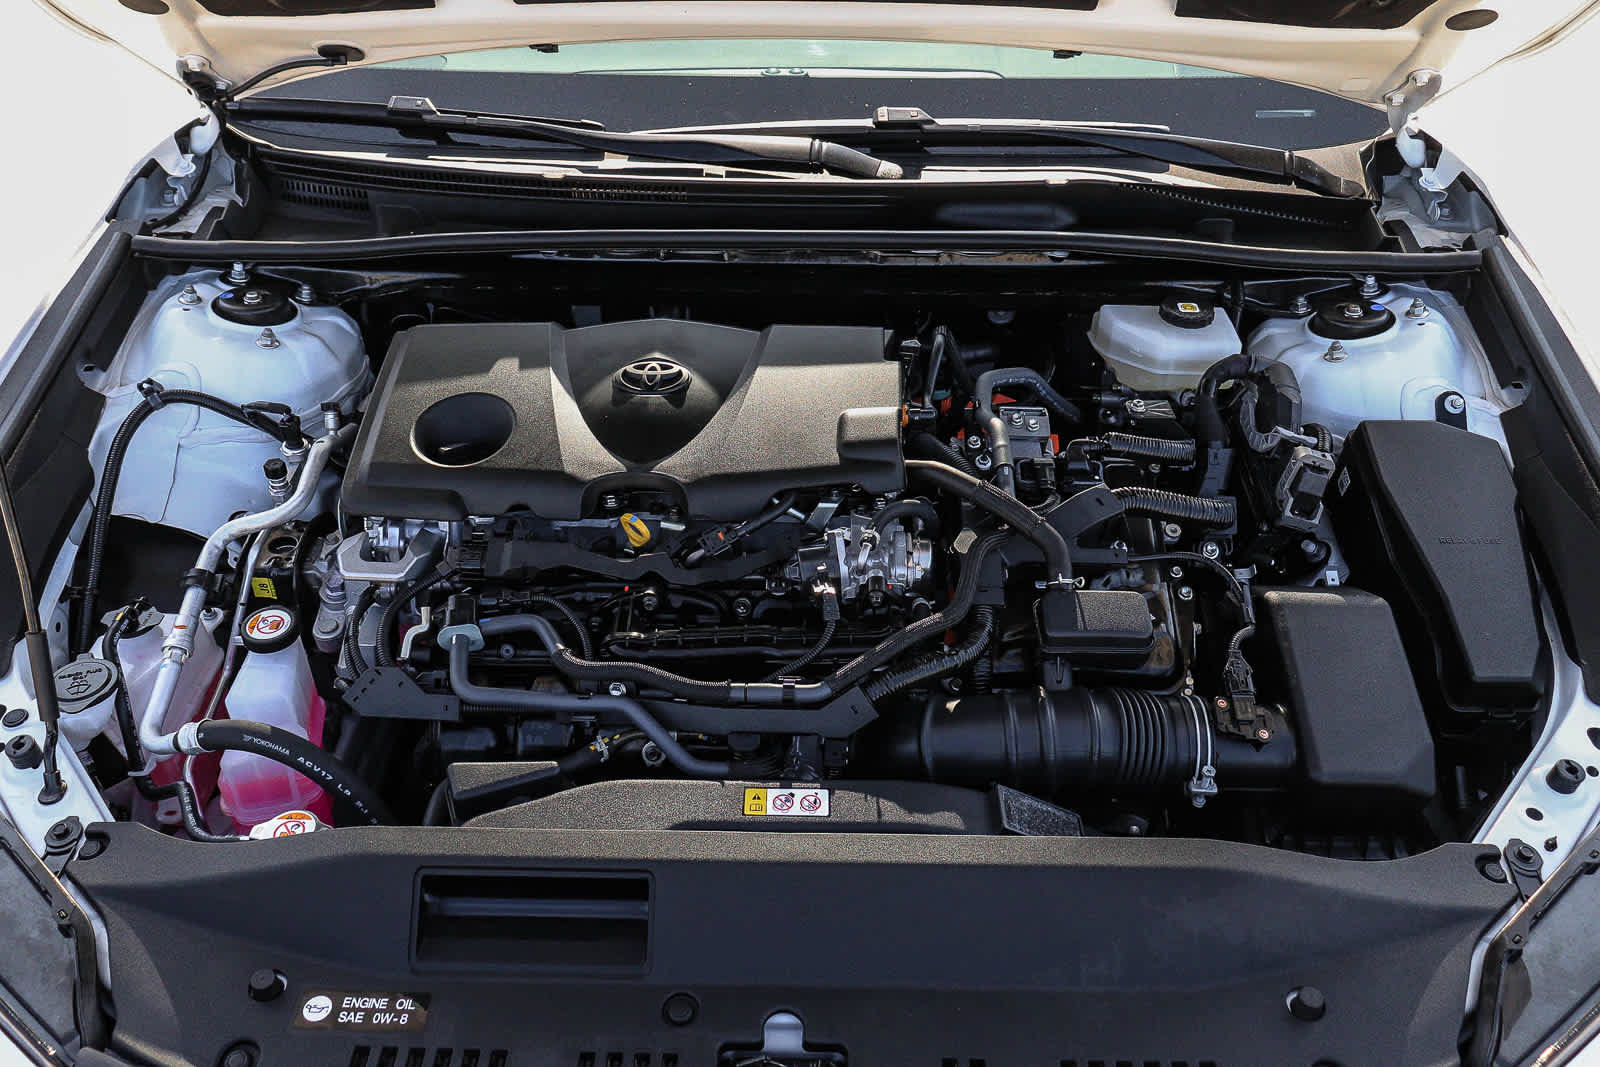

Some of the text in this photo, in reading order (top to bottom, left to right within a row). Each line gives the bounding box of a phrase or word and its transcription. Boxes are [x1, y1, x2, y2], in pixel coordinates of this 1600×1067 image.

[251, 736, 290, 755] YOKOHAMA
[297, 756, 334, 781] ACV17
[342, 996, 416, 1010] ENGINE OIL
[338, 1011, 409, 1025] SAE 0W-8
